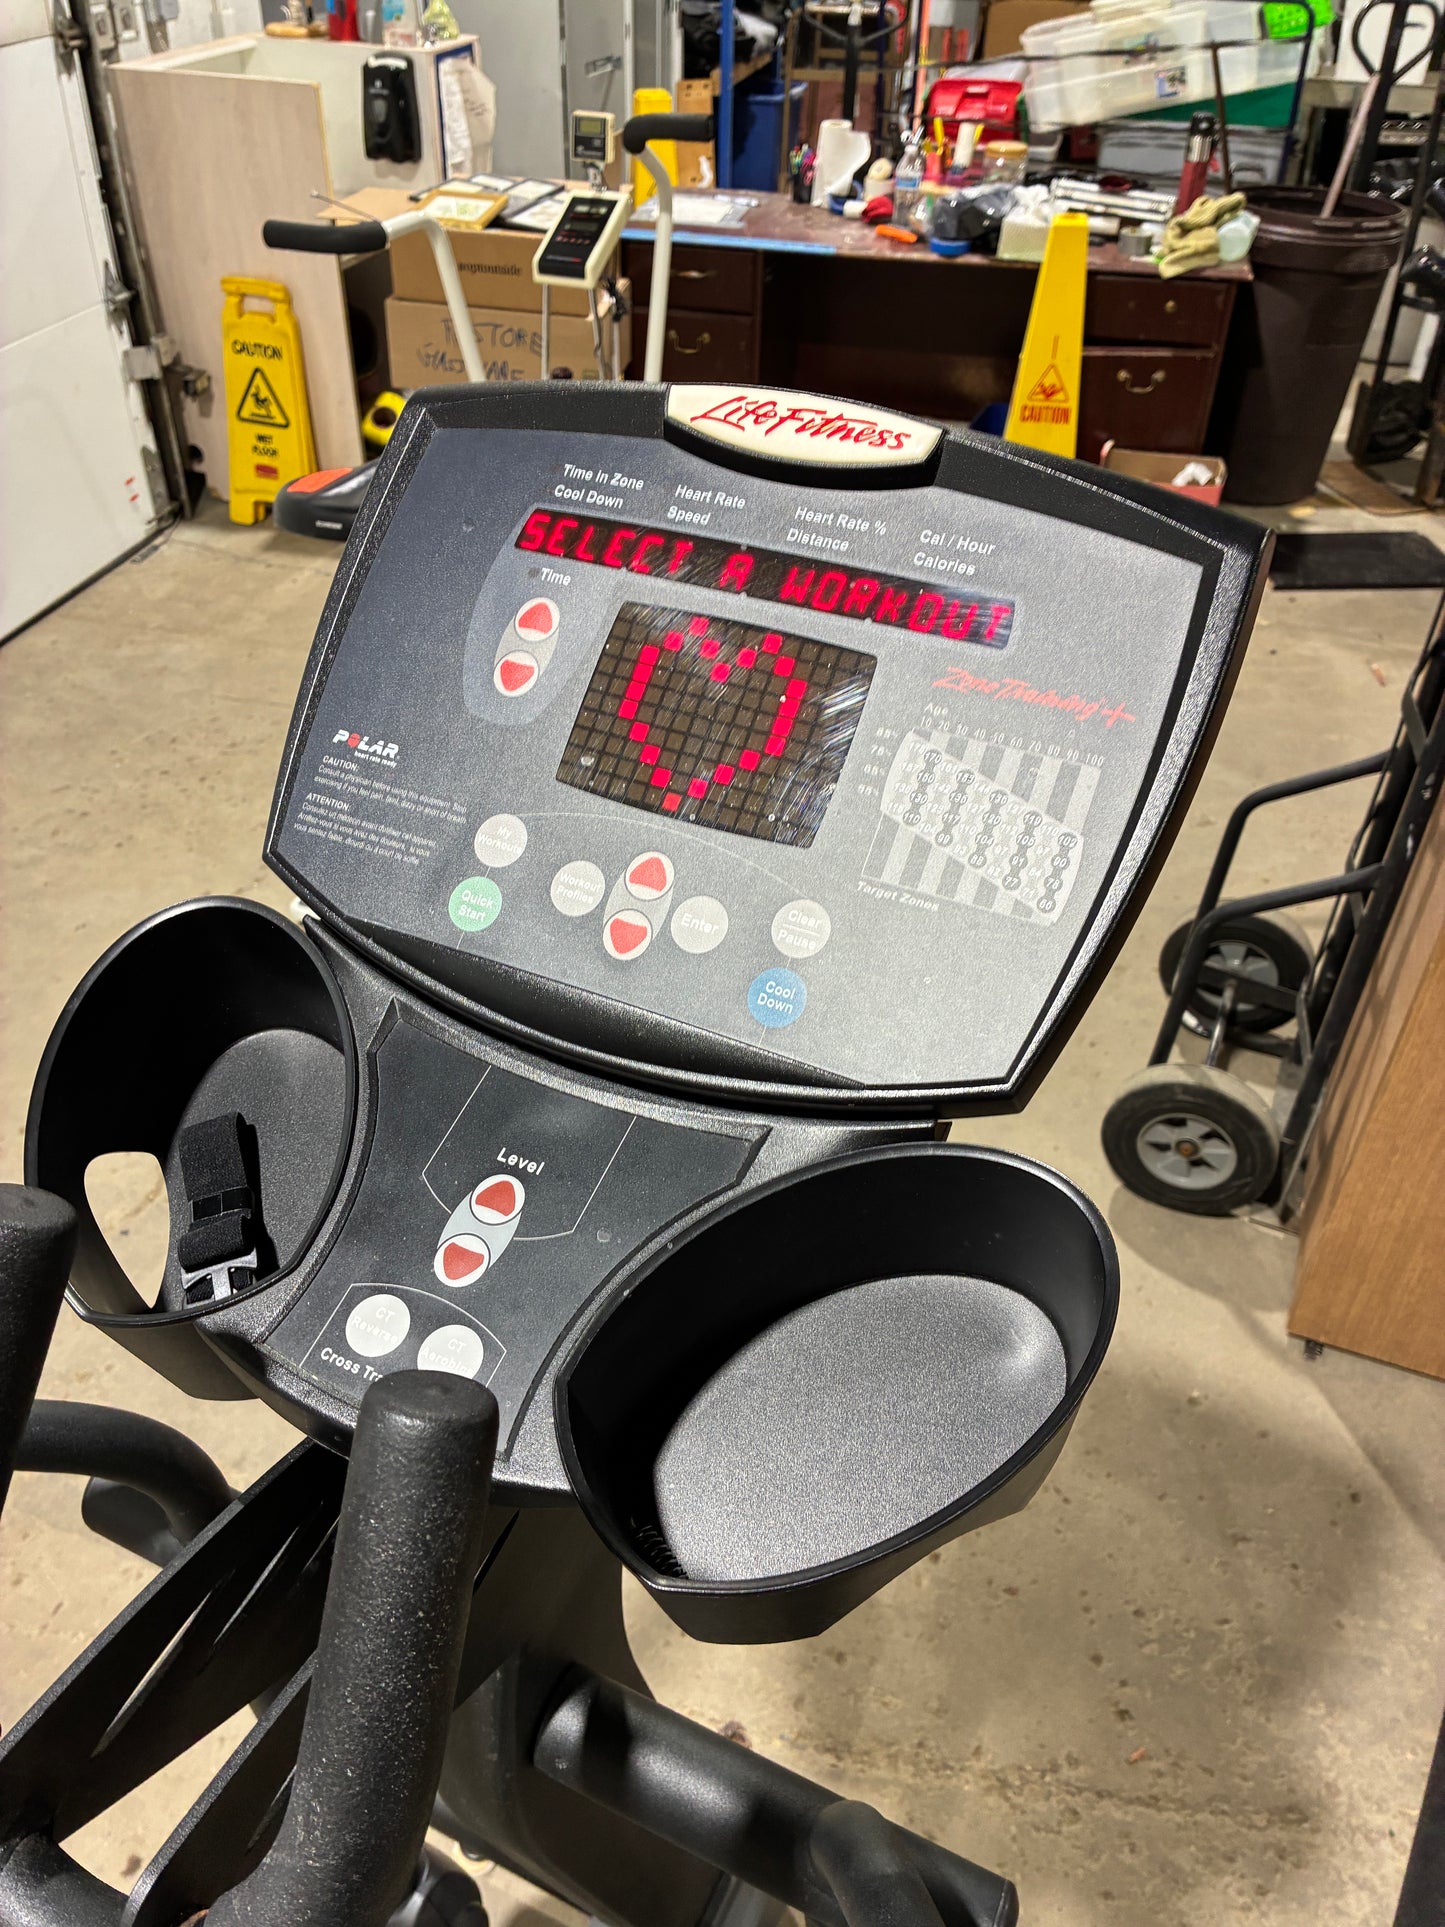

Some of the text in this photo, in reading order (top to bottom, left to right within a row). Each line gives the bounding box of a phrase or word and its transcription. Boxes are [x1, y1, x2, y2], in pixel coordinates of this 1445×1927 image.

[231, 339, 283, 359] CAUTION
[1020, 405, 1070, 424] CAUTION
[563, 464, 593, 481] Time
[610, 472, 644, 491] Zone
[554, 485, 624, 509] Cool Down
[675, 484, 745, 509] Heart Rate
[667, 506, 711, 525] Speed
[795, 506, 887, 536] Heart Rate %
[787, 528, 849, 551] Distance
[920, 529, 946, 547] Cal
[957, 537, 996, 555] Hour
[913, 552, 976, 576] Calories
[519, 513, 1011, 641] SELECT A WORKOUT
[541, 568, 571, 586] Time
[924, 702, 949, 716] Age
[332, 729, 399, 758] POLAR
[322, 755, 359, 772] CAUTION:
[354, 750, 397, 768] heart rate ready
[1047, 744, 1060, 757] 80
[1066, 748, 1080, 761] 90
[1085, 752, 1104, 767] 100
[305, 792, 351, 812] ATTENTION:
[496, 826, 512, 840] My
[559, 872, 601, 893] Workout
[461, 889, 494, 909] Quick
[556, 885, 594, 904] Profiles
[857, 881, 940, 912] Target Zones
[458, 904, 486, 922] Start
[680, 912, 719, 935] Enter
[788, 910, 821, 929] Clear
[777, 929, 817, 951] Pause
[765, 981, 796, 1000] Cool
[757, 993, 793, 1015] Down
[497, 1147, 545, 1175] Level
[375, 1306, 396, 1324] CT
[352, 1316, 399, 1344] Reverse
[447, 1338, 466, 1353] CT
[320, 1347, 360, 1374] Cross
